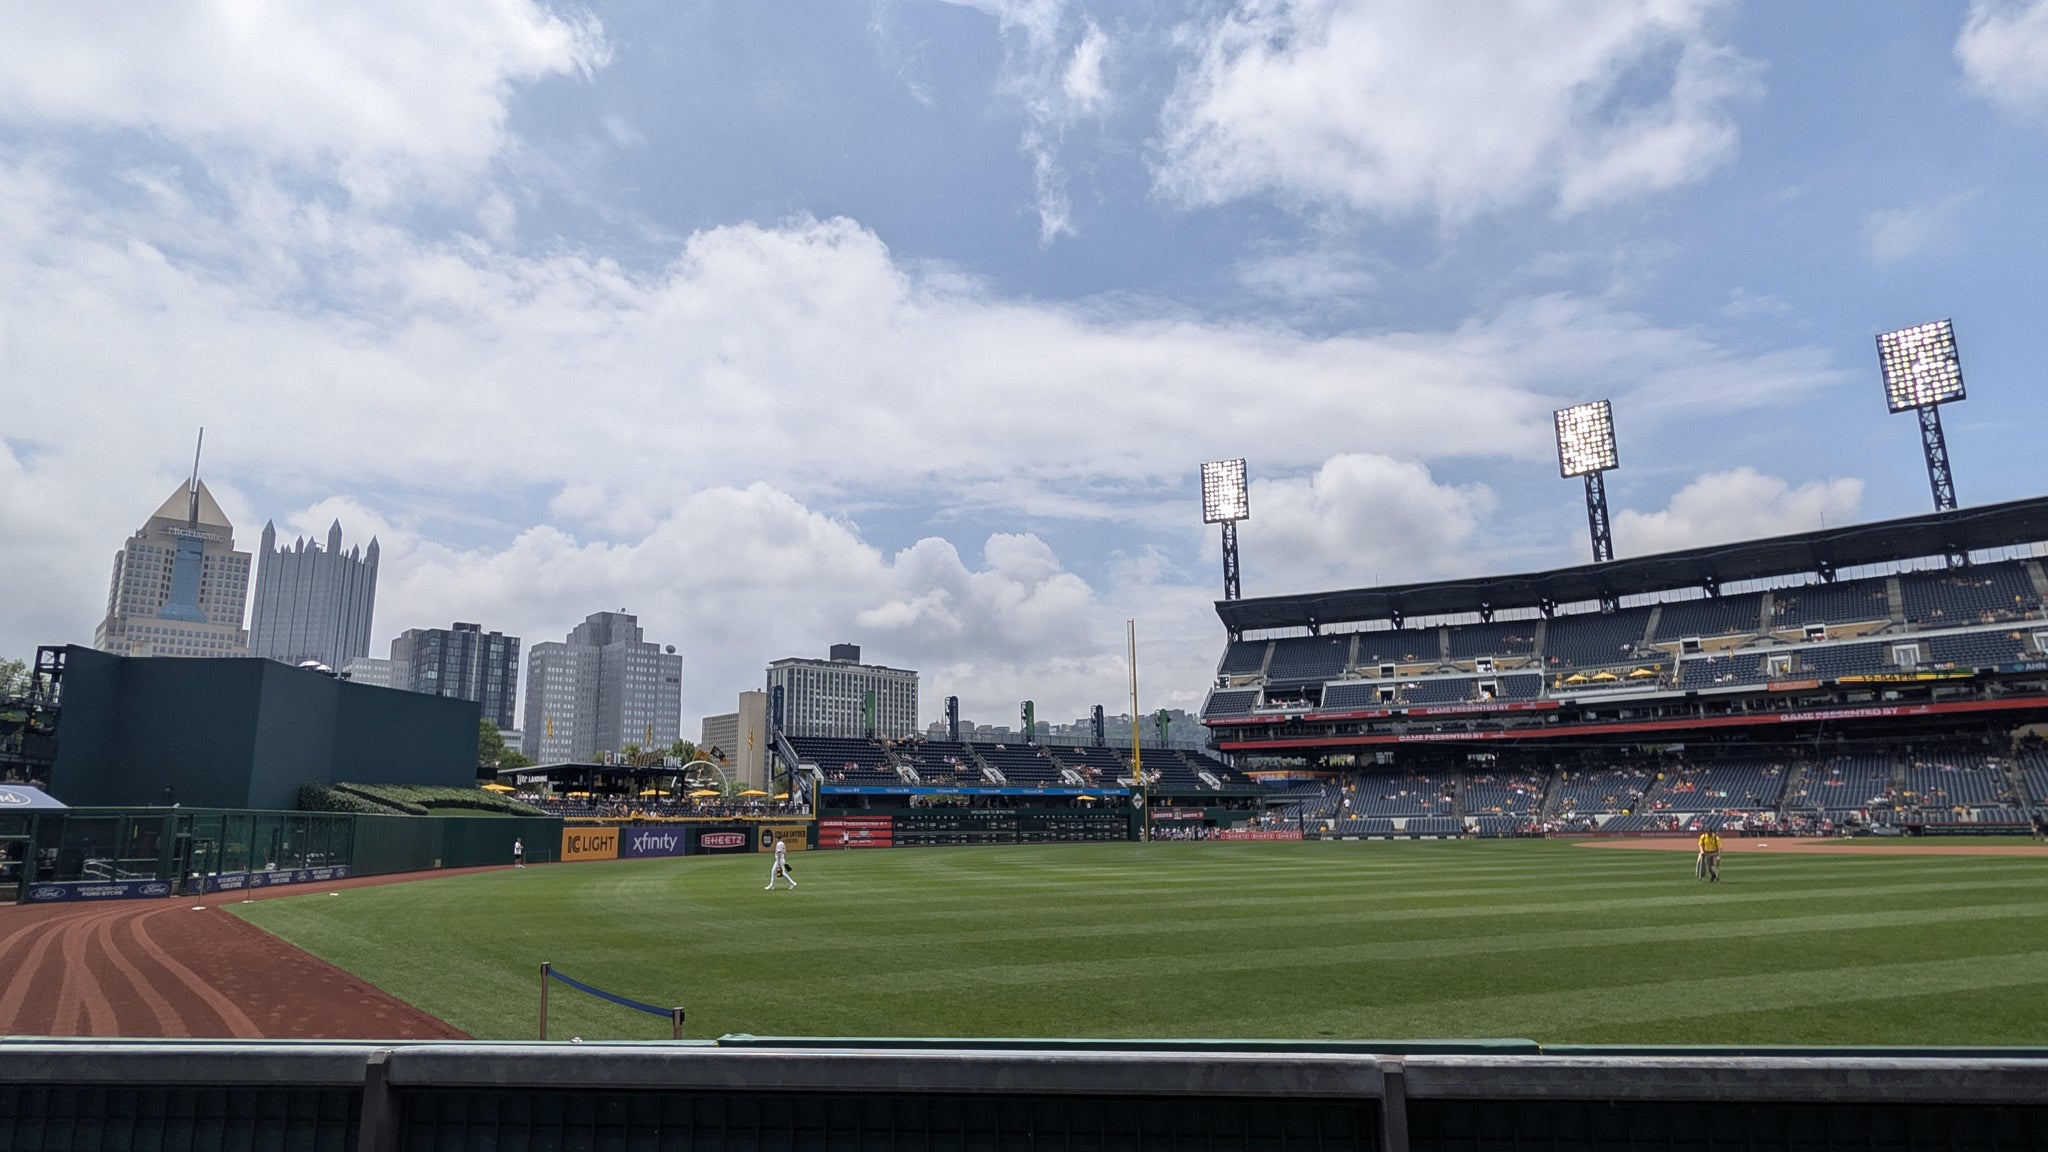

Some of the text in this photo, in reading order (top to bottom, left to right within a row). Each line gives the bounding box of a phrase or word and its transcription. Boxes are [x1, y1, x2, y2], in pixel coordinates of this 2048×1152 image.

[2025, 662, 2047, 671] AHN
[1426, 703, 1510, 714] GAME PRESENTED BY
[1780, 707, 1898, 721] GAME PRESENTED BY
[1398, 734, 1424, 742] GAME
[1424, 733, 1472, 741] PRESENTED
[613, 752, 629, 765] IT'S
[663, 756, 682, 767] TIME
[568, 836, 614, 853] IC LIGHT
[633, 832, 678, 852] xfinity
[704, 835, 742, 845] SHEETZ
[35, 887, 60, 898] Ford
[143, 883, 166, 894] Ford
